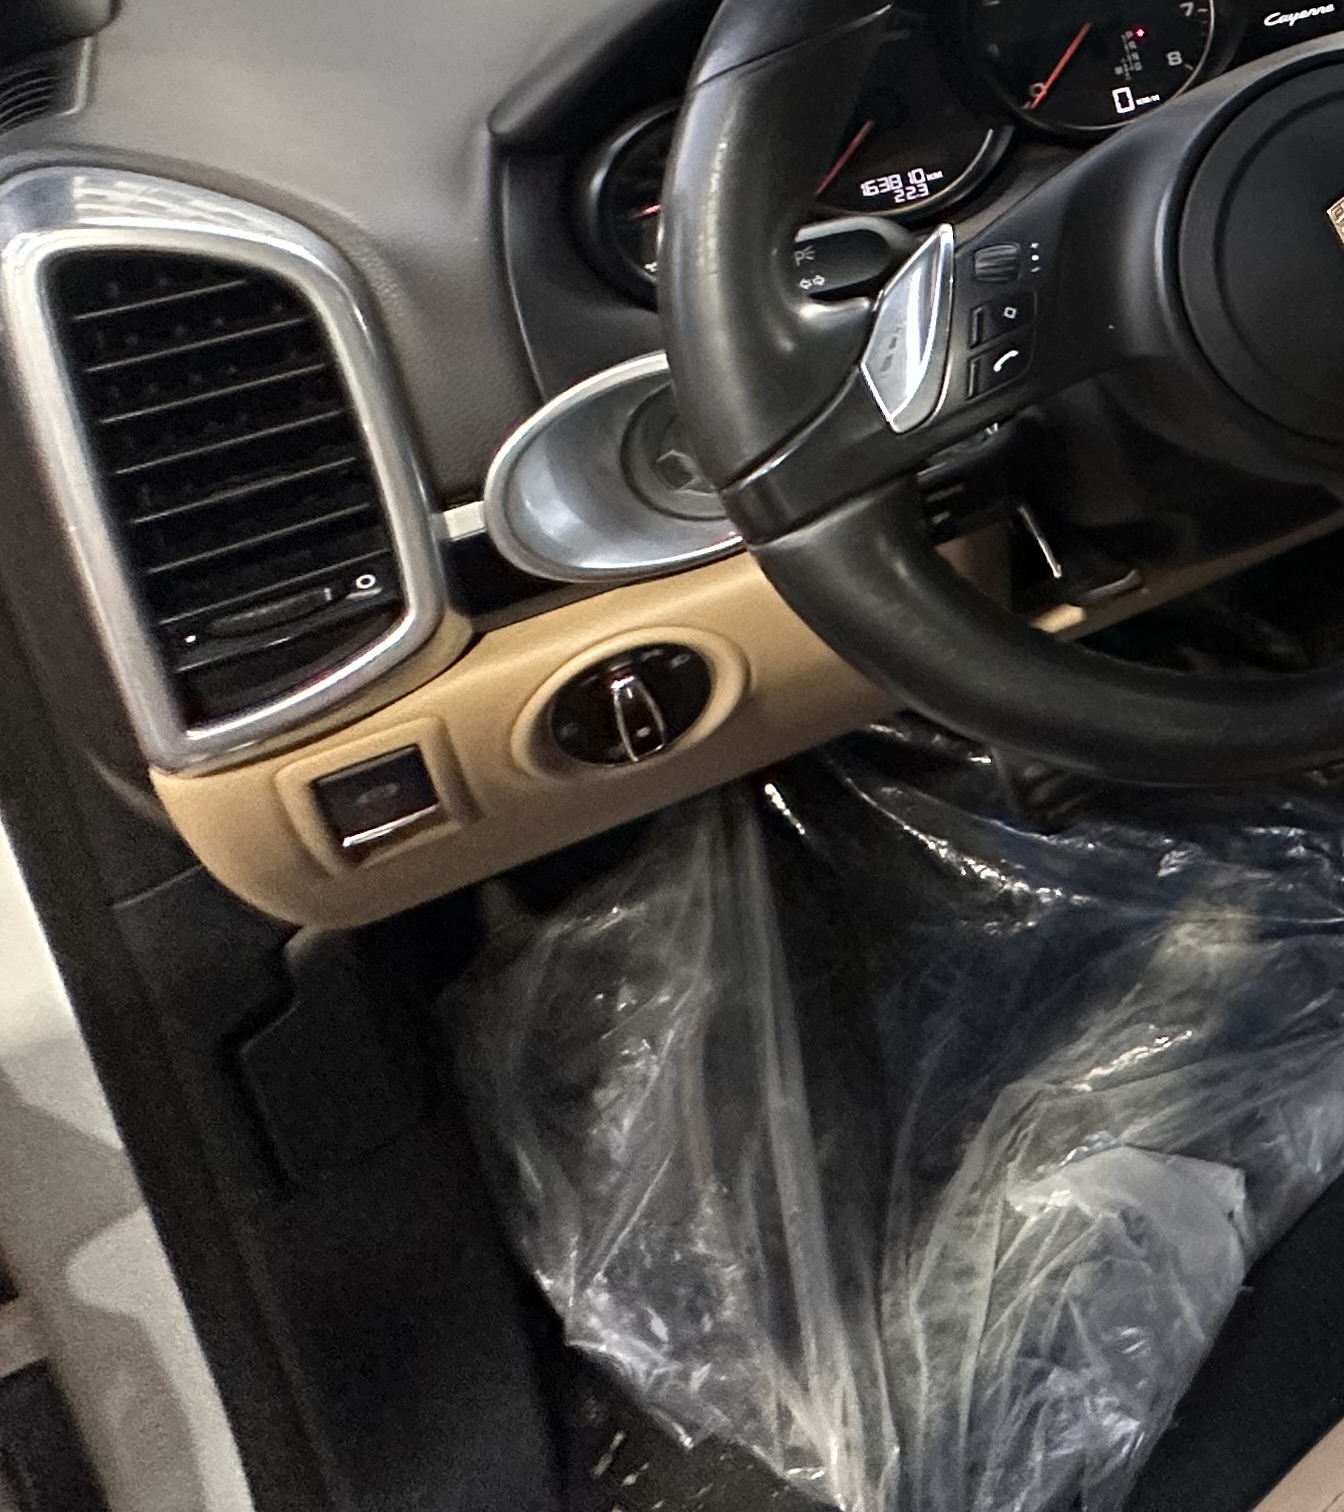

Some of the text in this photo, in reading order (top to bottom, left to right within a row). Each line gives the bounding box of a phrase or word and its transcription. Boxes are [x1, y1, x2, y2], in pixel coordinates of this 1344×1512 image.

[1179, 1, 1194, 17] 7
[1264, 3, 1335, 27] Cayenne
[1166, 50, 1184, 67] 8
[1111, 86, 1135, 114] 0
